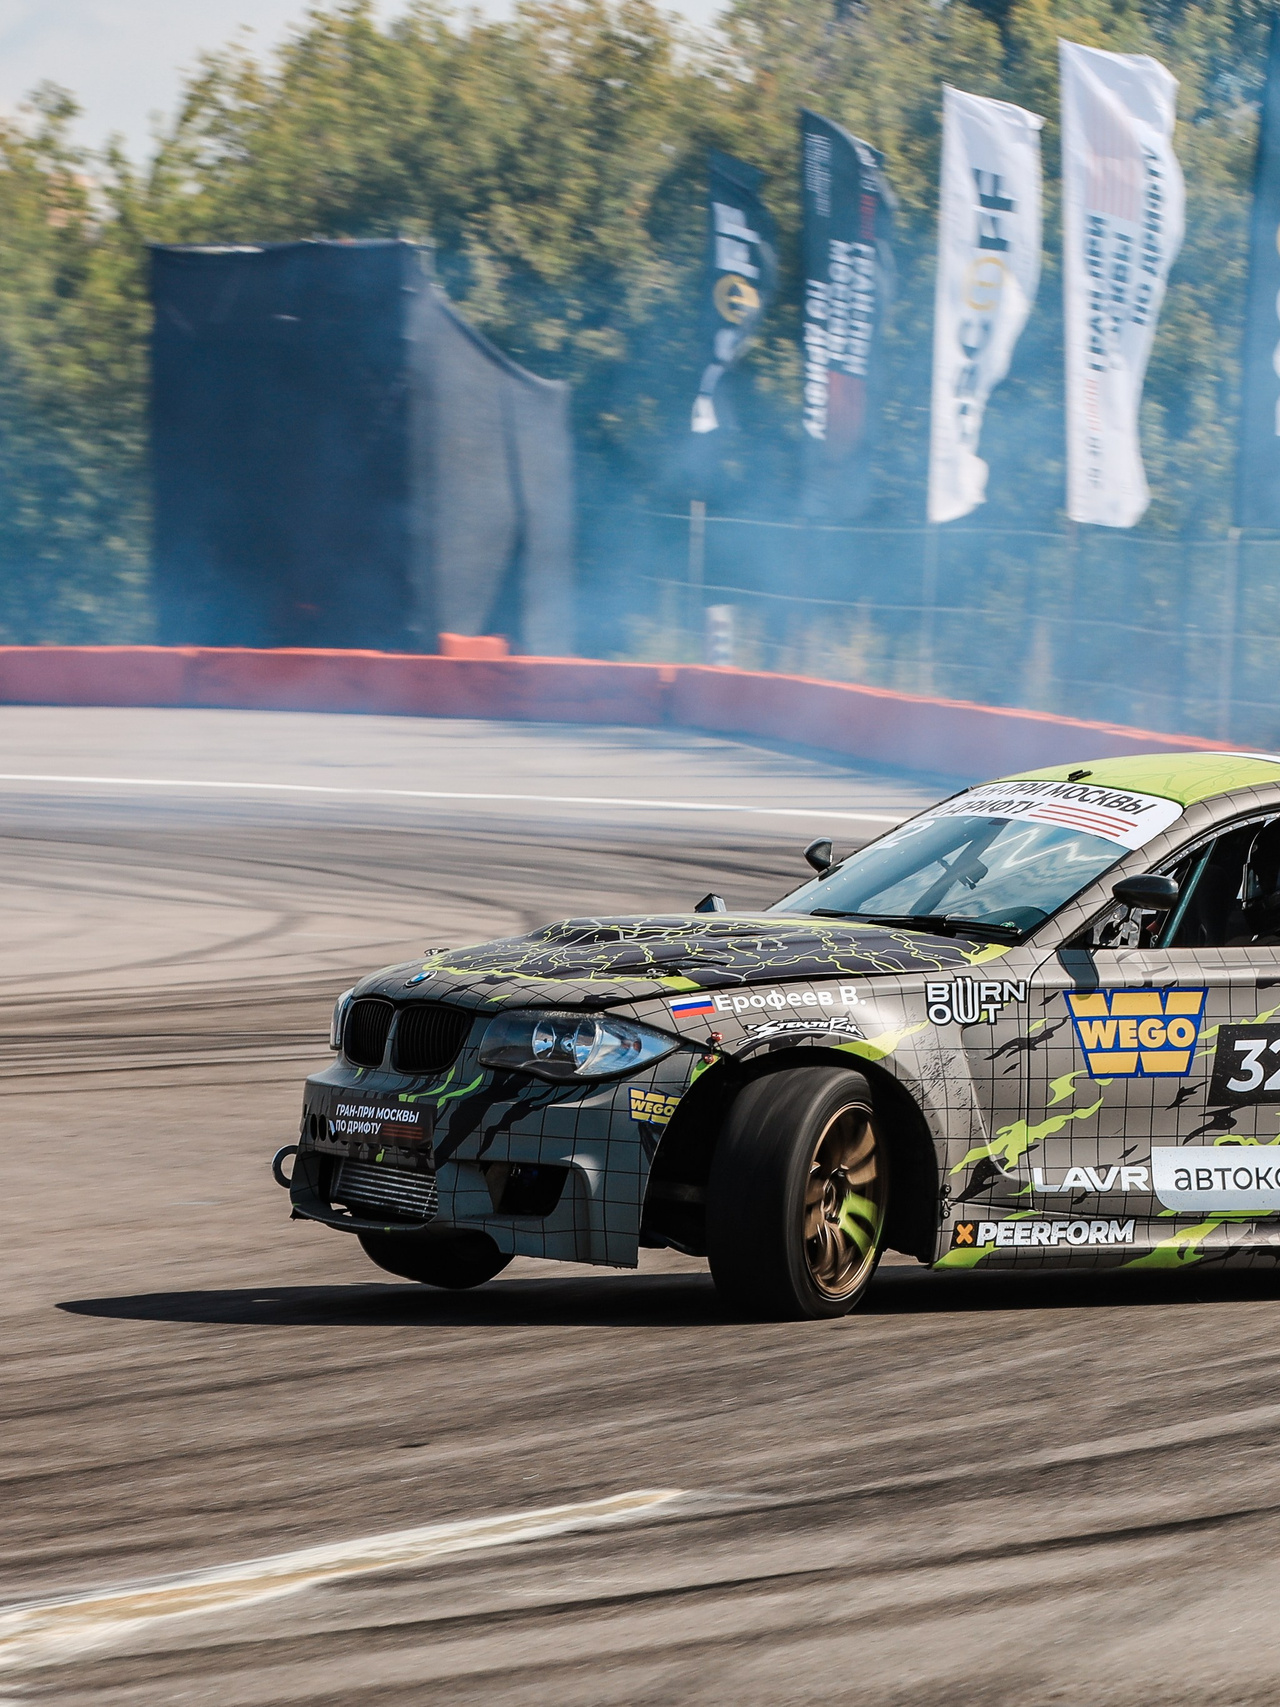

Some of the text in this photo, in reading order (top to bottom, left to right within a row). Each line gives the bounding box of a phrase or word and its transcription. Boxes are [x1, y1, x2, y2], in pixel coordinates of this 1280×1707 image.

[1042, 783, 1157, 815] МОСКВЫ
[713, 986, 866, 1013] Ерофеев В.
[926, 976, 1026, 1003] BURN
[1076, 1017, 1196, 1049] WEGO
[335, 1104, 420, 1124] ГРАН-ПРИ МОСКВЫ
[630, 1098, 676, 1117] WEGO
[335, 1119, 382, 1135] ПО ДРИФТУ
[1033, 1166, 1150, 1192] LAVR
